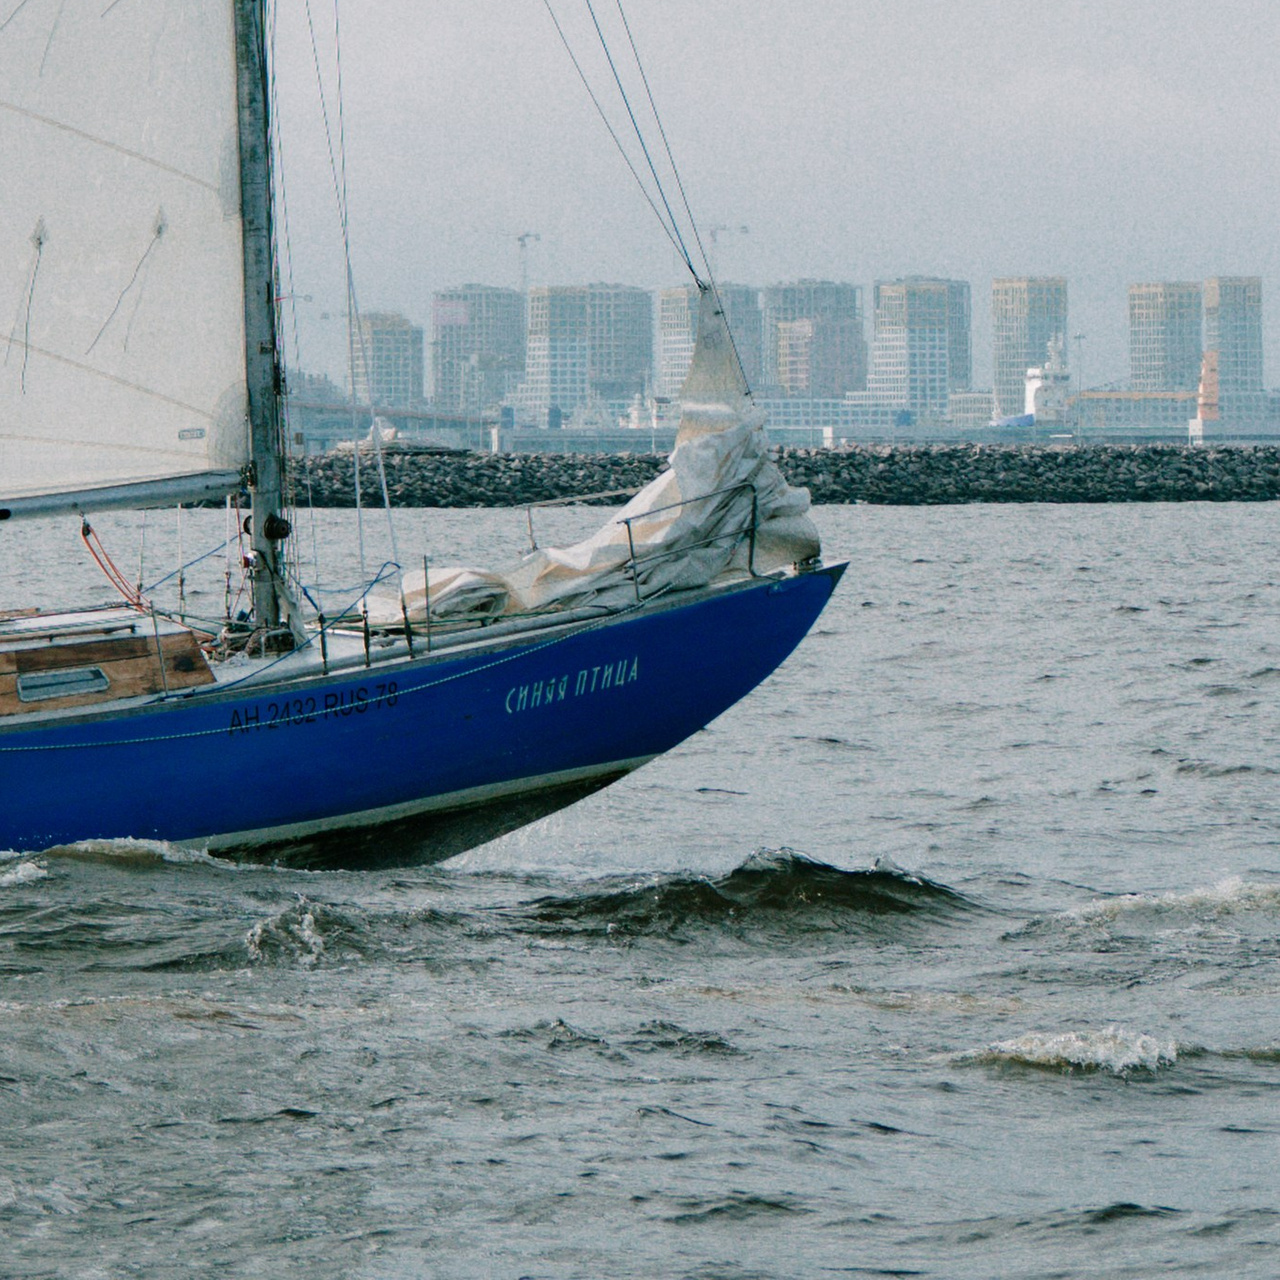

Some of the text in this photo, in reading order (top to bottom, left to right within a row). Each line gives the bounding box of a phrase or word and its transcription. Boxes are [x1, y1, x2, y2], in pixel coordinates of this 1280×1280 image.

[575, 655, 638, 696] ПТИЦА
[268, 697, 317, 730] 2432
[324, 687, 369, 720] RUS
[376, 681, 399, 709] 78
